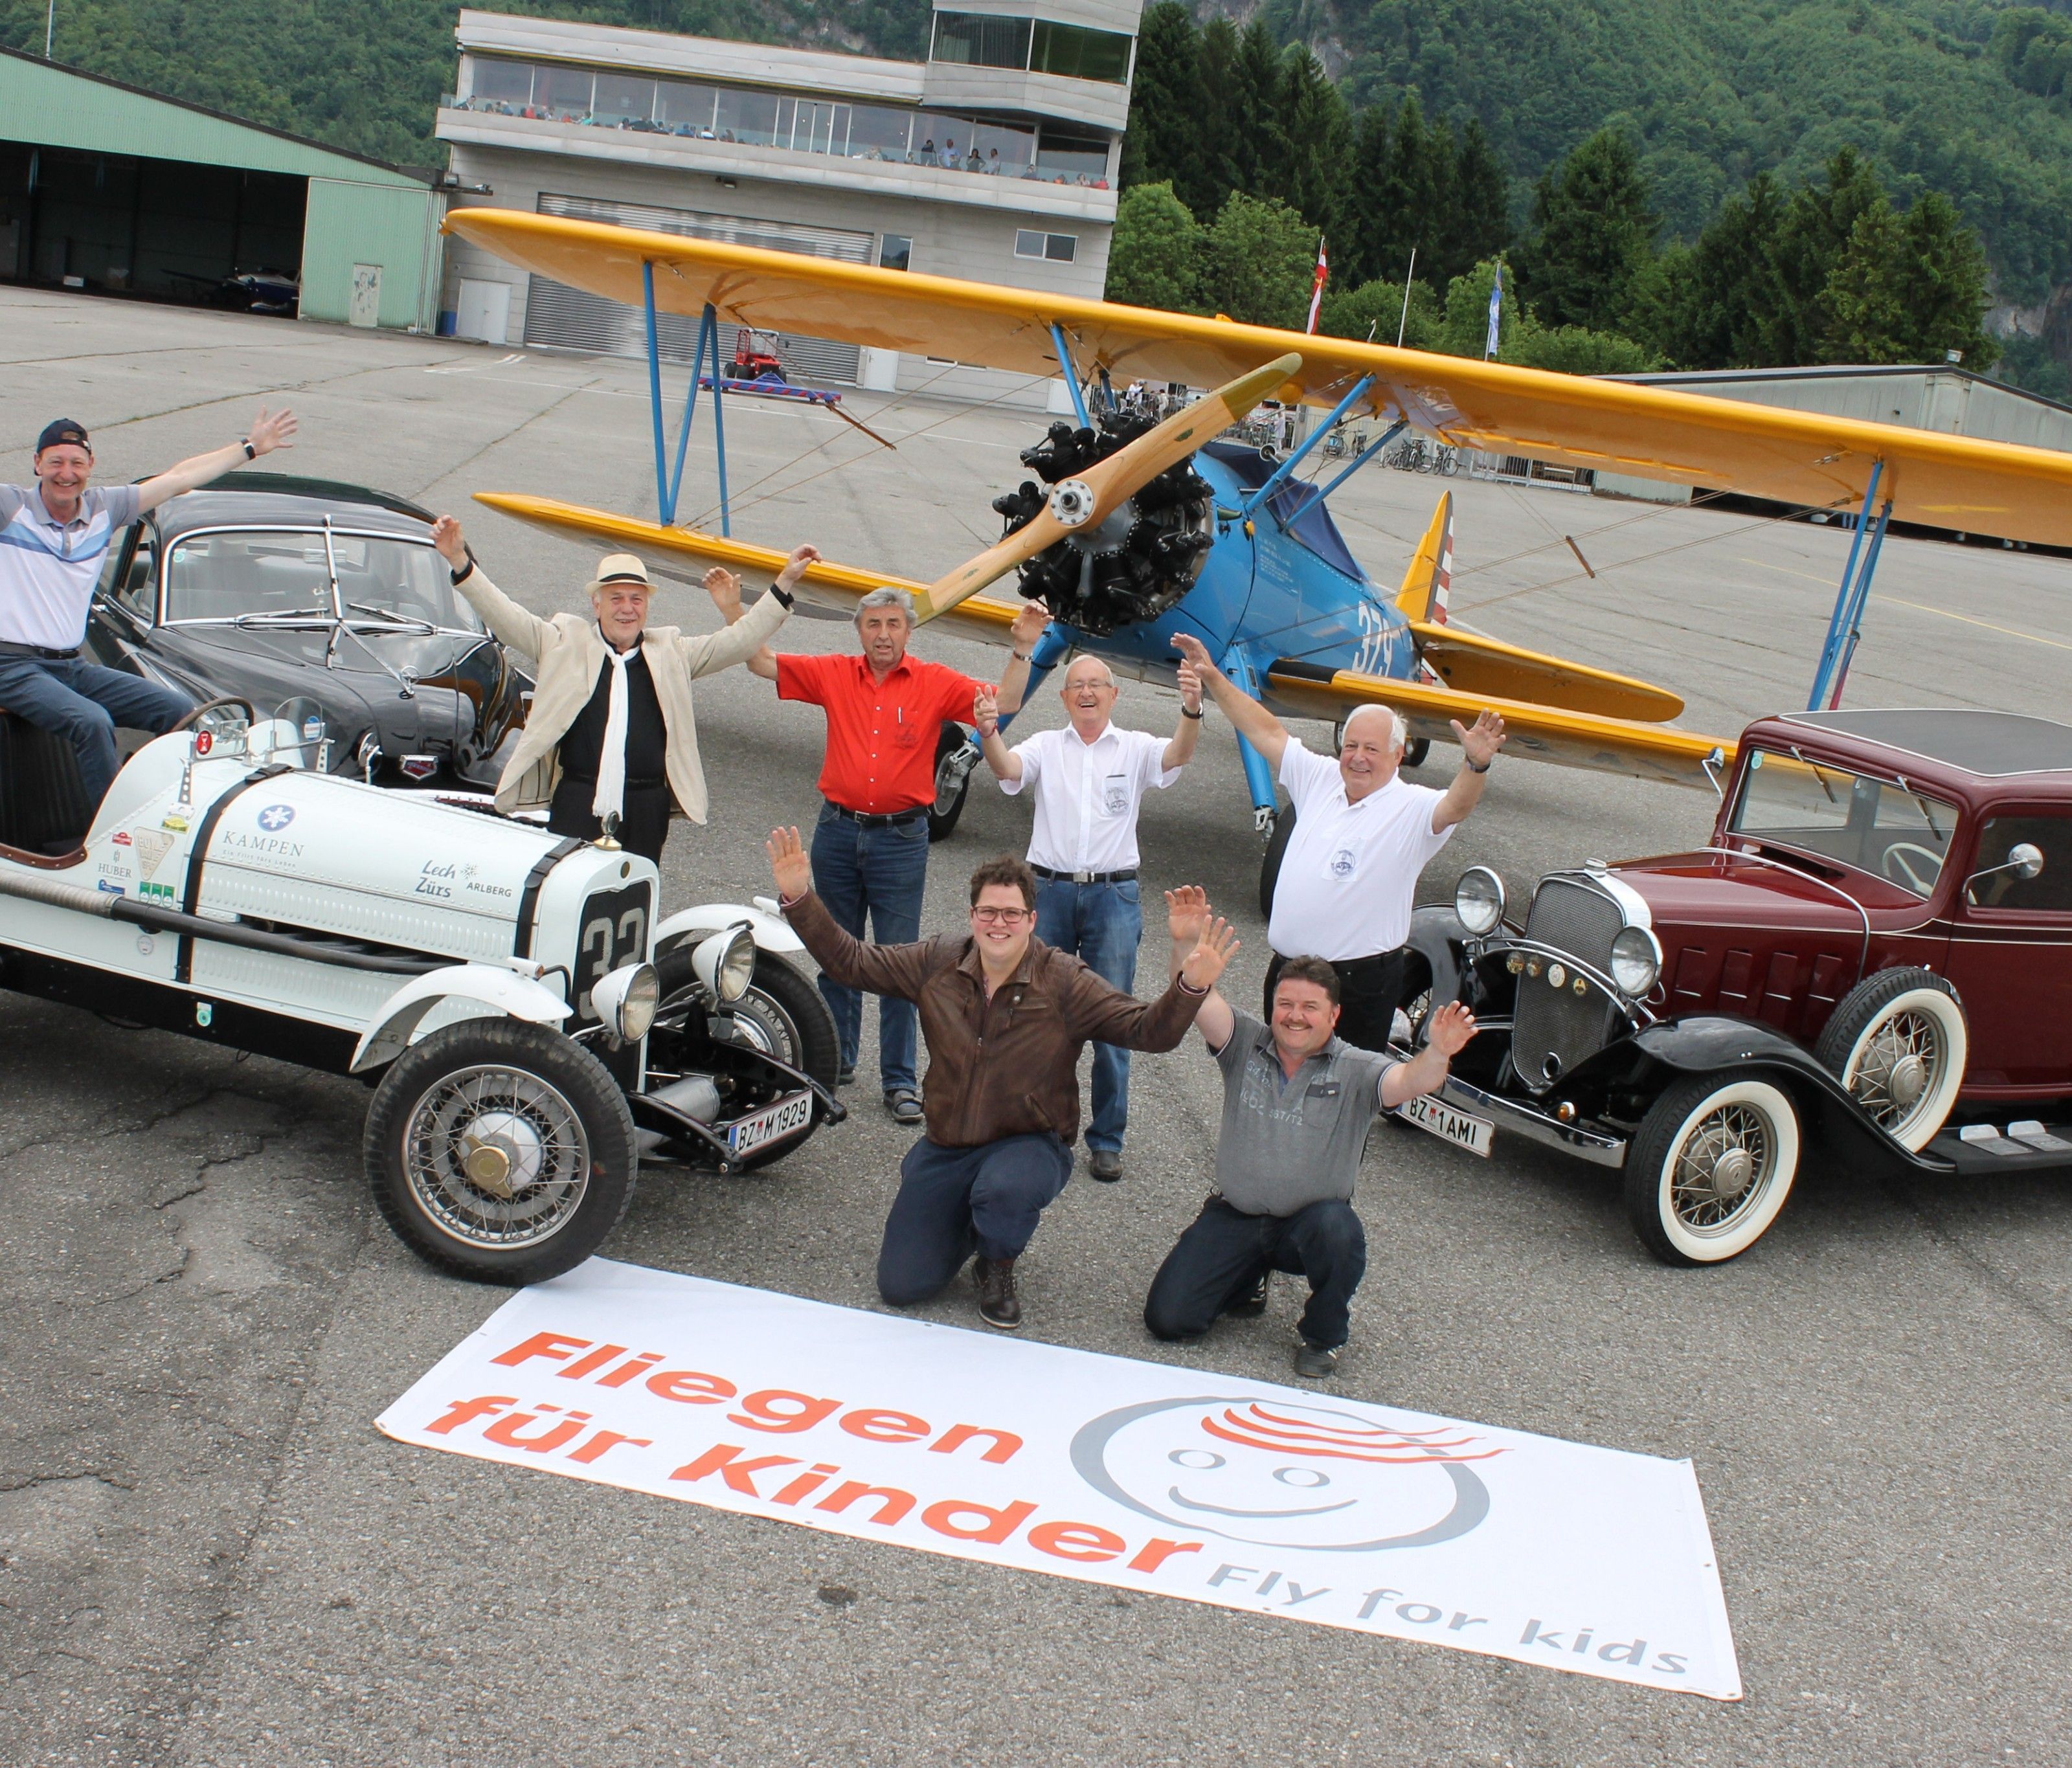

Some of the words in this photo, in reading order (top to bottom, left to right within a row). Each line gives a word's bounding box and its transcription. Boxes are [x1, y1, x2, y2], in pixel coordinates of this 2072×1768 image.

[1351, 600, 1393, 678] 379
[223, 831, 304, 857] KAMPEN
[98, 862, 132, 878] HUBER
[415, 877, 451, 898] Zürs
[422, 859, 456, 879] Lech
[466, 882, 513, 897] ARLBERG
[738, 1121, 756, 1151] BZ
[763, 1113, 774, 1139] M
[777, 1099, 807, 1133] 1929
[1410, 1097, 1428, 1122] BZ
[1438, 1111, 1476, 1145] 1AMI
[491, 1332, 1023, 1464] Fliegen
[425, 1395, 653, 1464] für
[670, 1444, 1204, 1573] Kinder
[1206, 1563, 1331, 1606] Fly
[1356, 1589, 1489, 1631] for
[1519, 1619, 1689, 1675] kids
